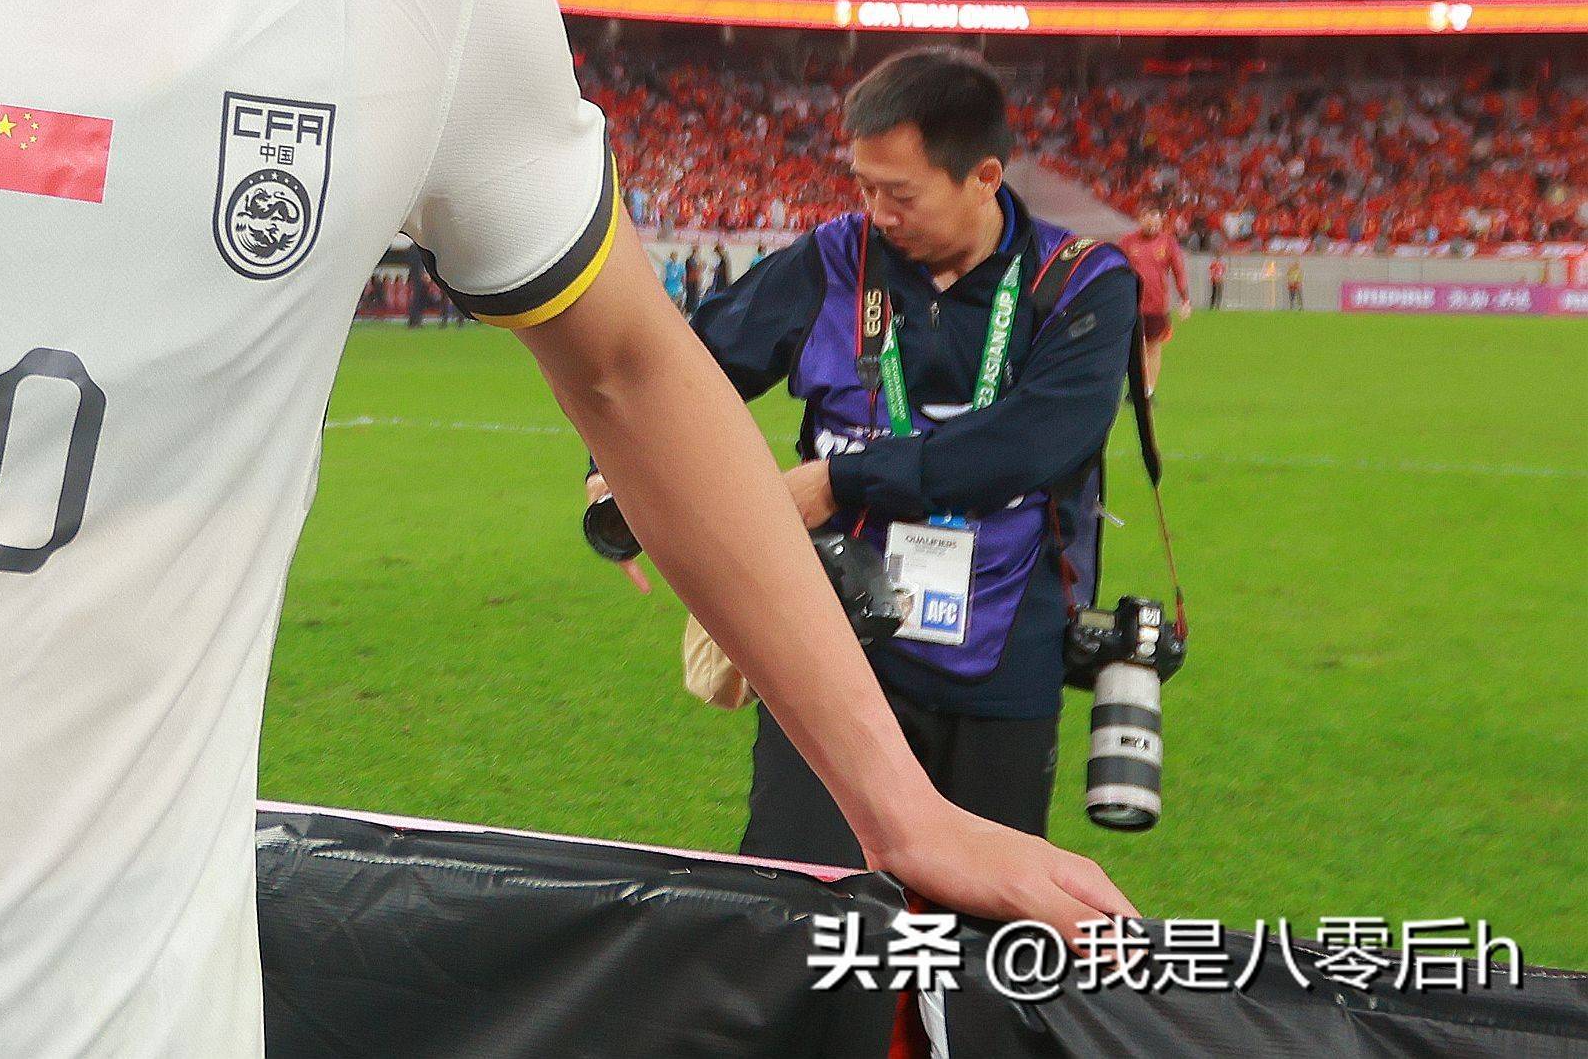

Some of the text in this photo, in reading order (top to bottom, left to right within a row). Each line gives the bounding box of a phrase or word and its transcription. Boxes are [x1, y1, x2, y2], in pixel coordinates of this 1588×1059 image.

[233, 105, 324, 146] CFA
[259, 142, 295, 165] 中国
[865, 289, 882, 337] EOS
[995, 292, 1014, 329] CUP
[927, 599, 959, 627] AFC
